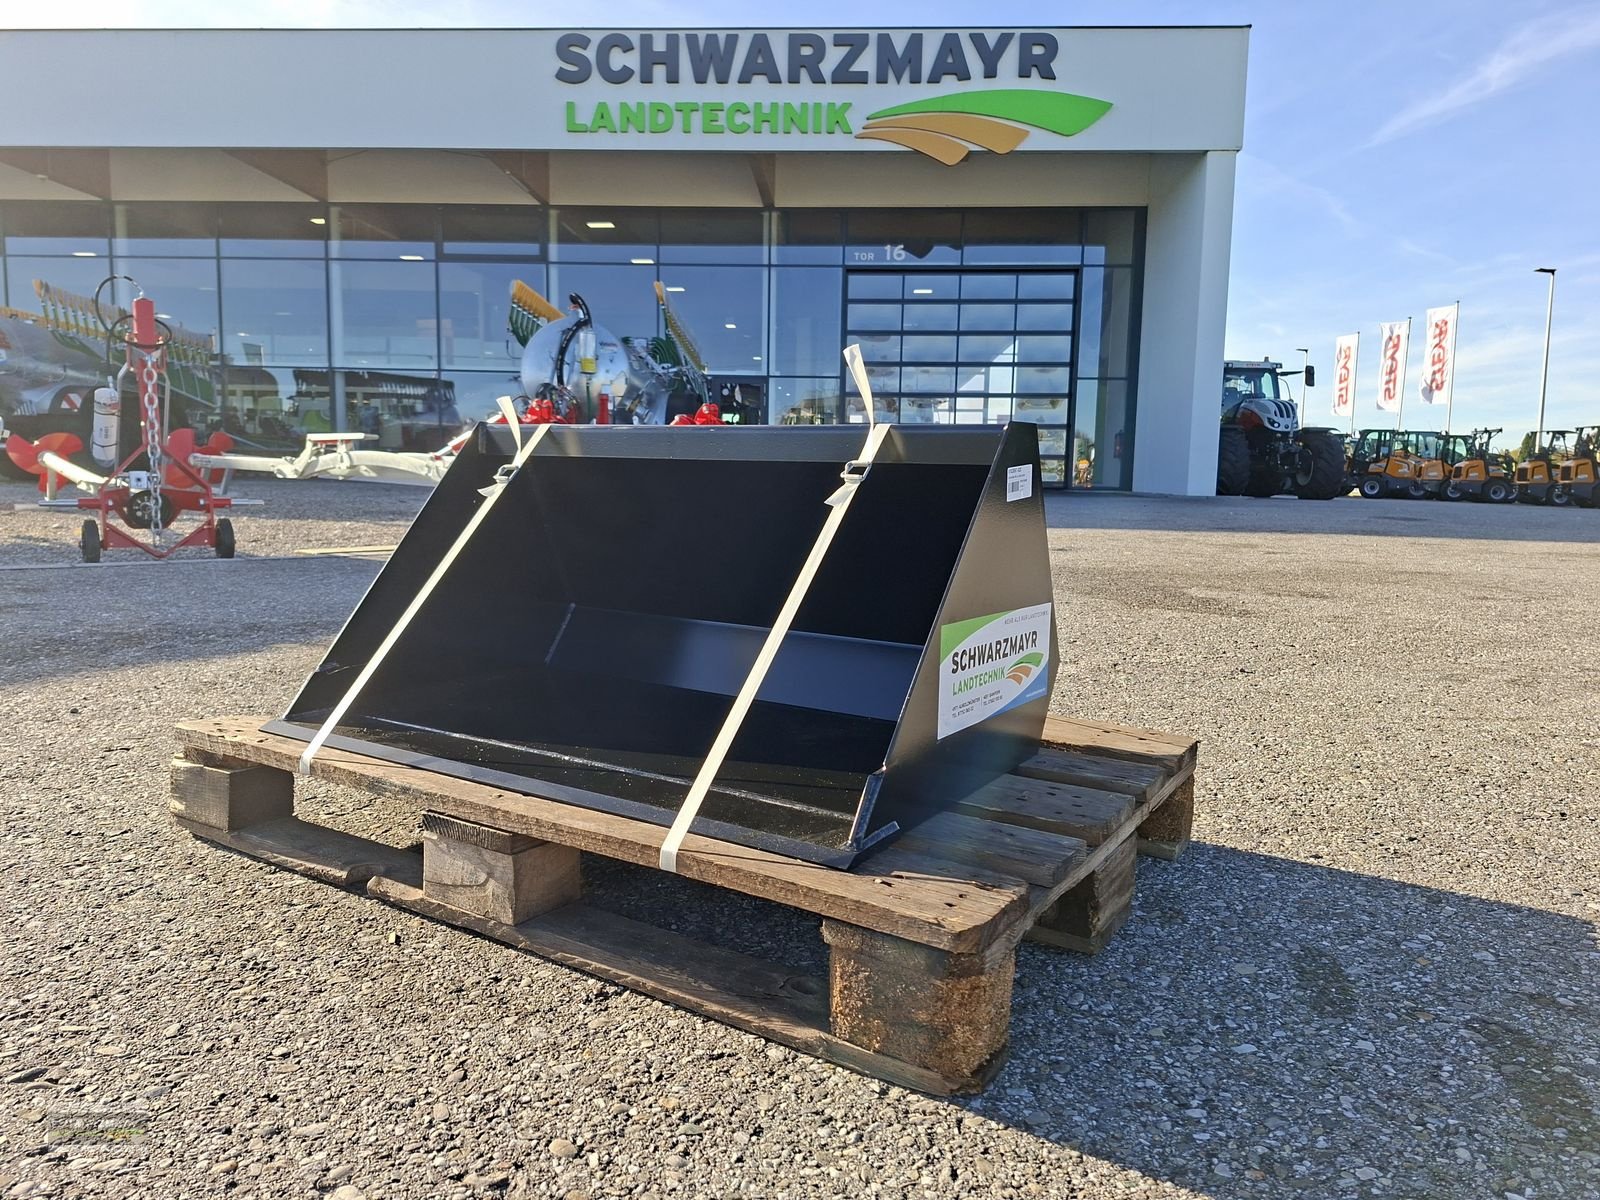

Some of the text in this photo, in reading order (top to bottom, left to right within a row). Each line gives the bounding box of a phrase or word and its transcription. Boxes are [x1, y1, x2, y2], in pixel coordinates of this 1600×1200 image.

[554, 31, 1060, 86] SCHWARZMAYR
[565, 101, 854, 135] LANDTECHNIK
[854, 244, 906, 261] TOR 16
[951, 630, 1038, 675] SCHWARZMAYR
[952, 666, 1006, 697] LANDTECHNIK
